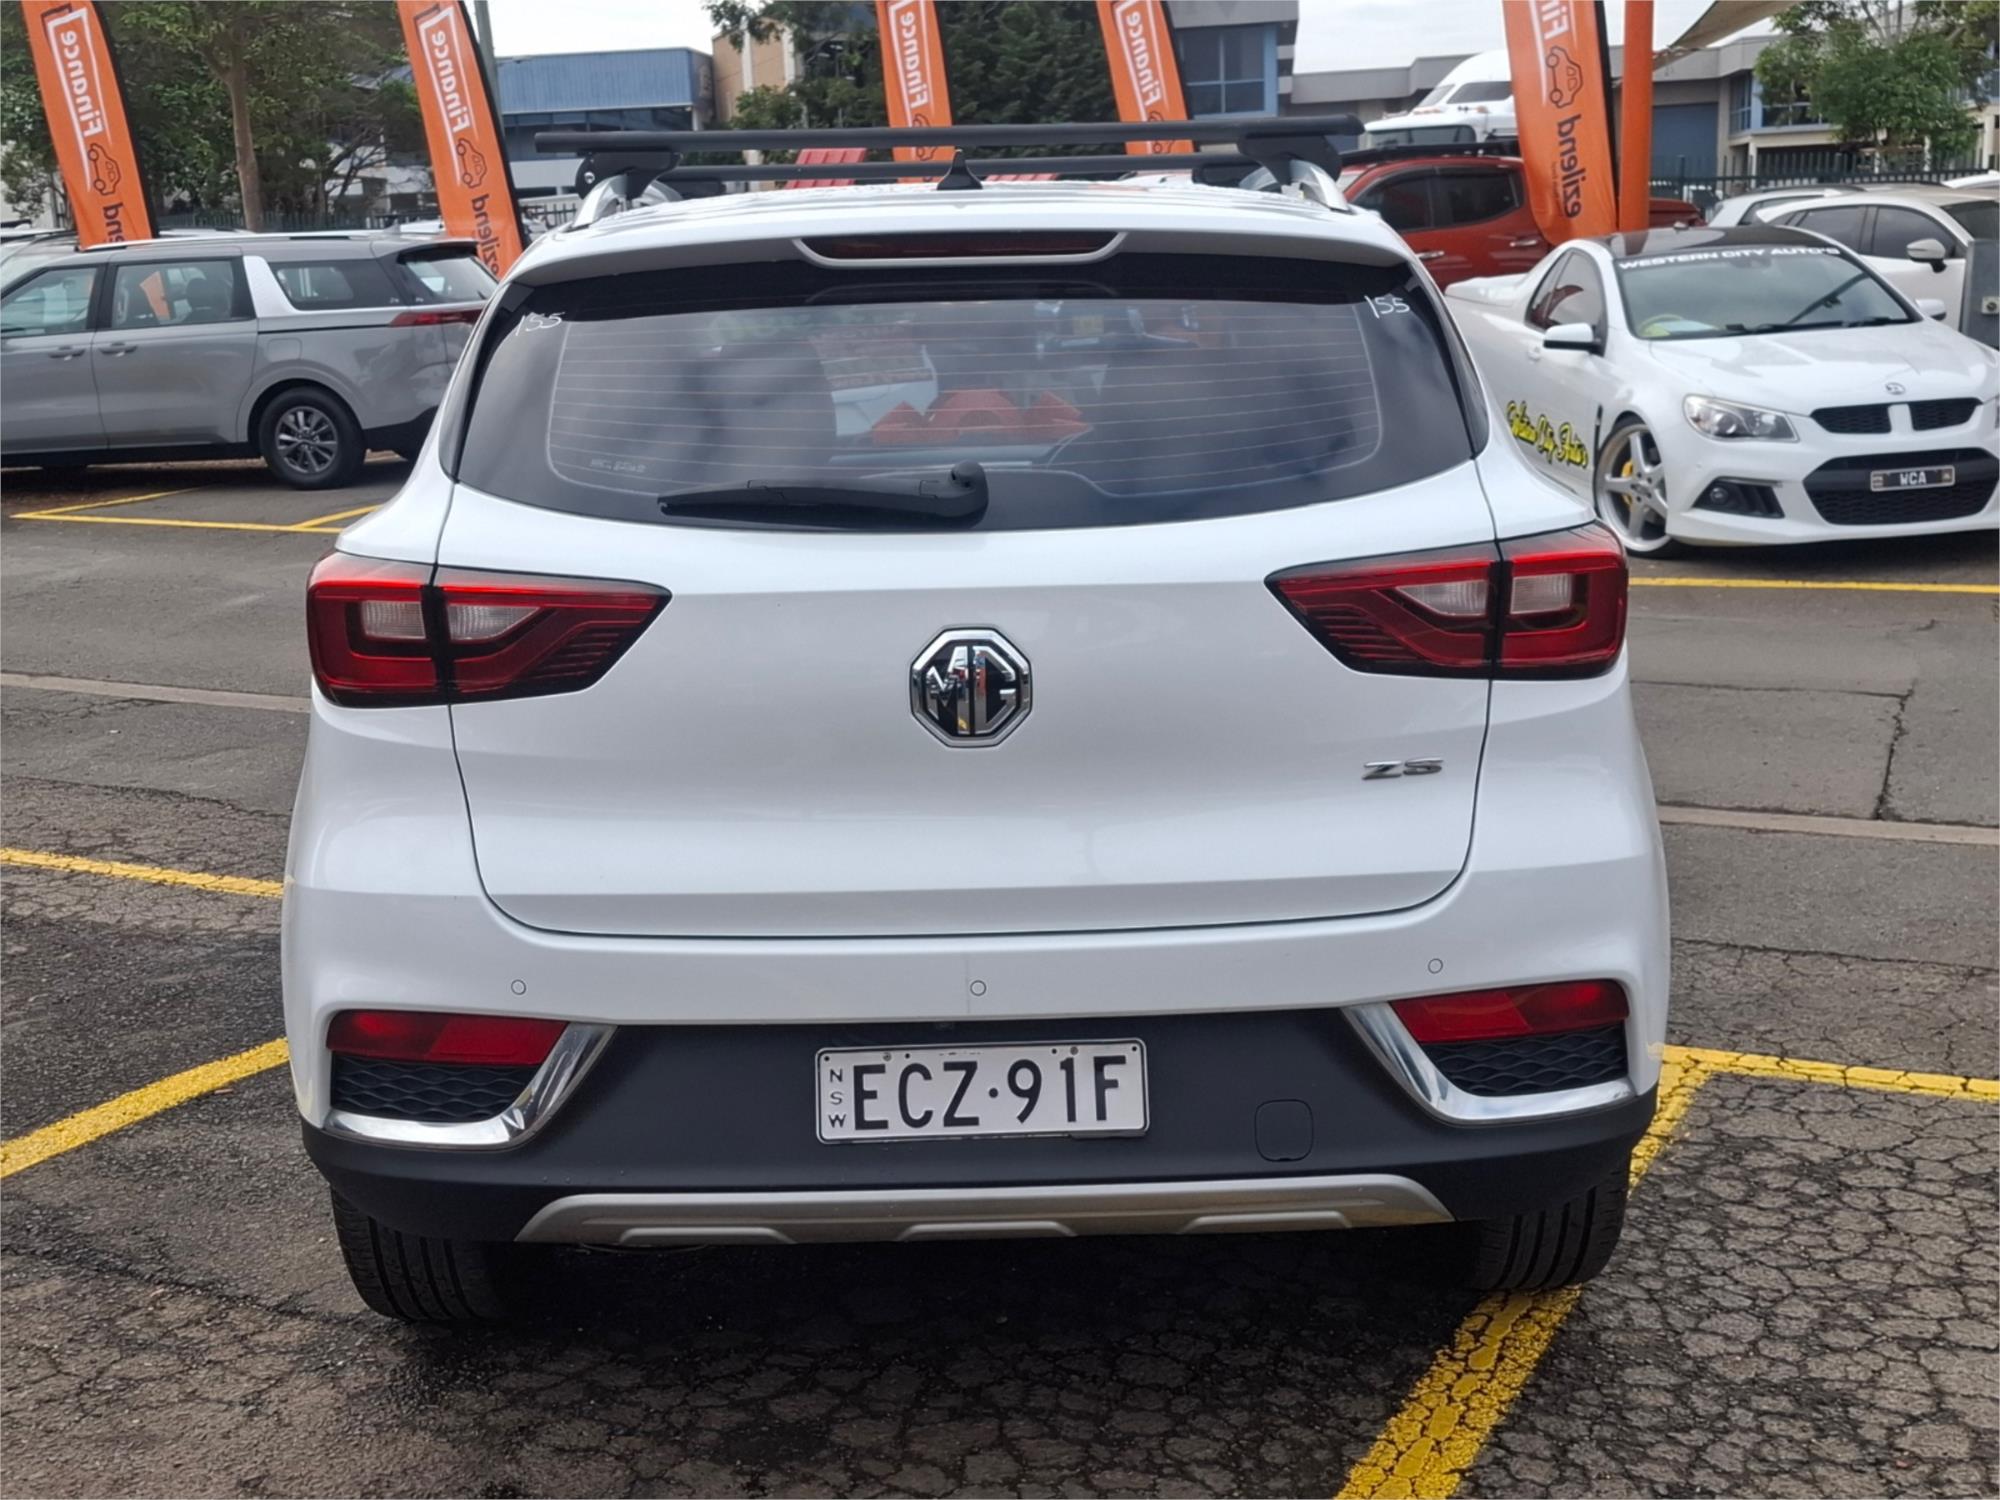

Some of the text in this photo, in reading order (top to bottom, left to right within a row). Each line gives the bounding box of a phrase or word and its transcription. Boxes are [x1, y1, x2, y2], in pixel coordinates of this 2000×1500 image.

[1619, 250, 1718, 269] WESTERN
[1722, 249, 1765, 258] CITY
[1364, 294, 1410, 318] 155
[515, 311, 566, 336] 155
[1900, 471, 1927, 486] WCA
[924, 642, 1018, 737] MG
[1362, 757, 1443, 780] ZS
